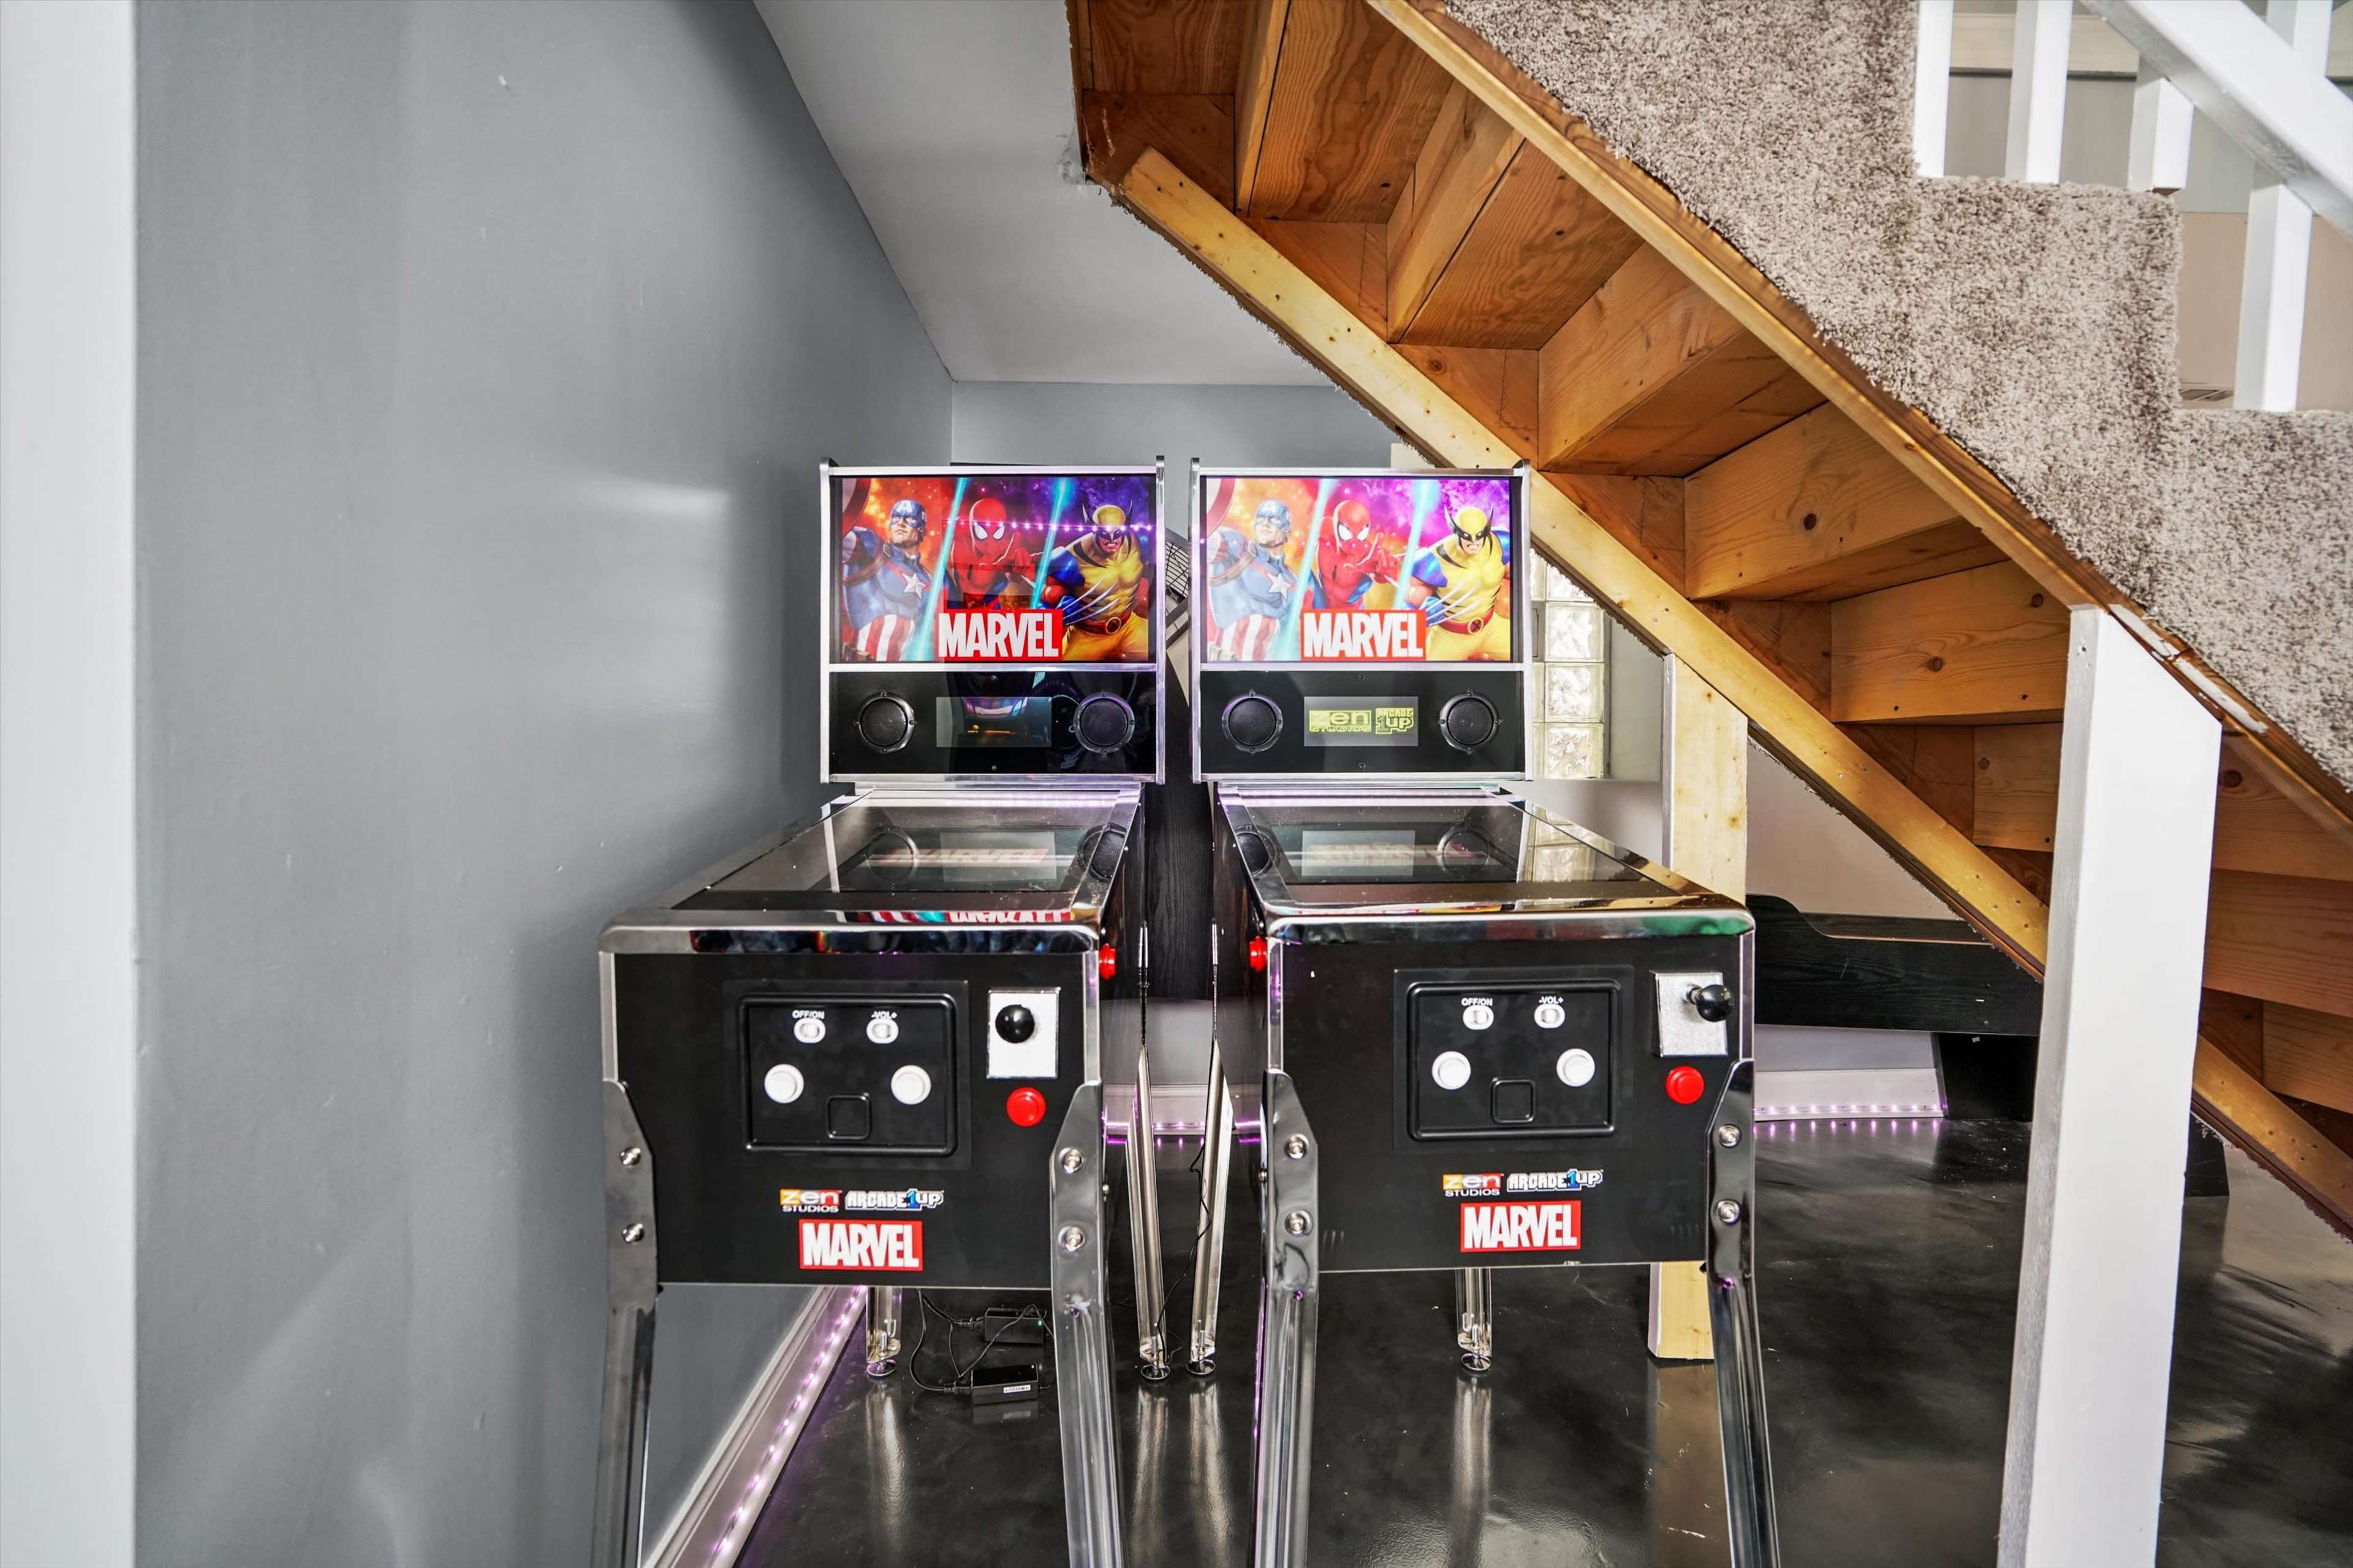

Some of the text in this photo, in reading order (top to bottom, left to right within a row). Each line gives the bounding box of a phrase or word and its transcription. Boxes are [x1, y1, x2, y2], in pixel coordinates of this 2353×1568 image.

[939, 612, 1059, 657] MARVEL
[1303, 612, 1423, 657] MARVEL
[1310, 711, 1371, 725] en
[1461, 998, 1493, 1006] OFF/ON
[1445, 1189, 1500, 1197] STUDIOS
[782, 1205, 839, 1213] STUDIOS
[1463, 1204, 1577, 1249] MARVEL
[803, 1222, 919, 1268] MARVEL
